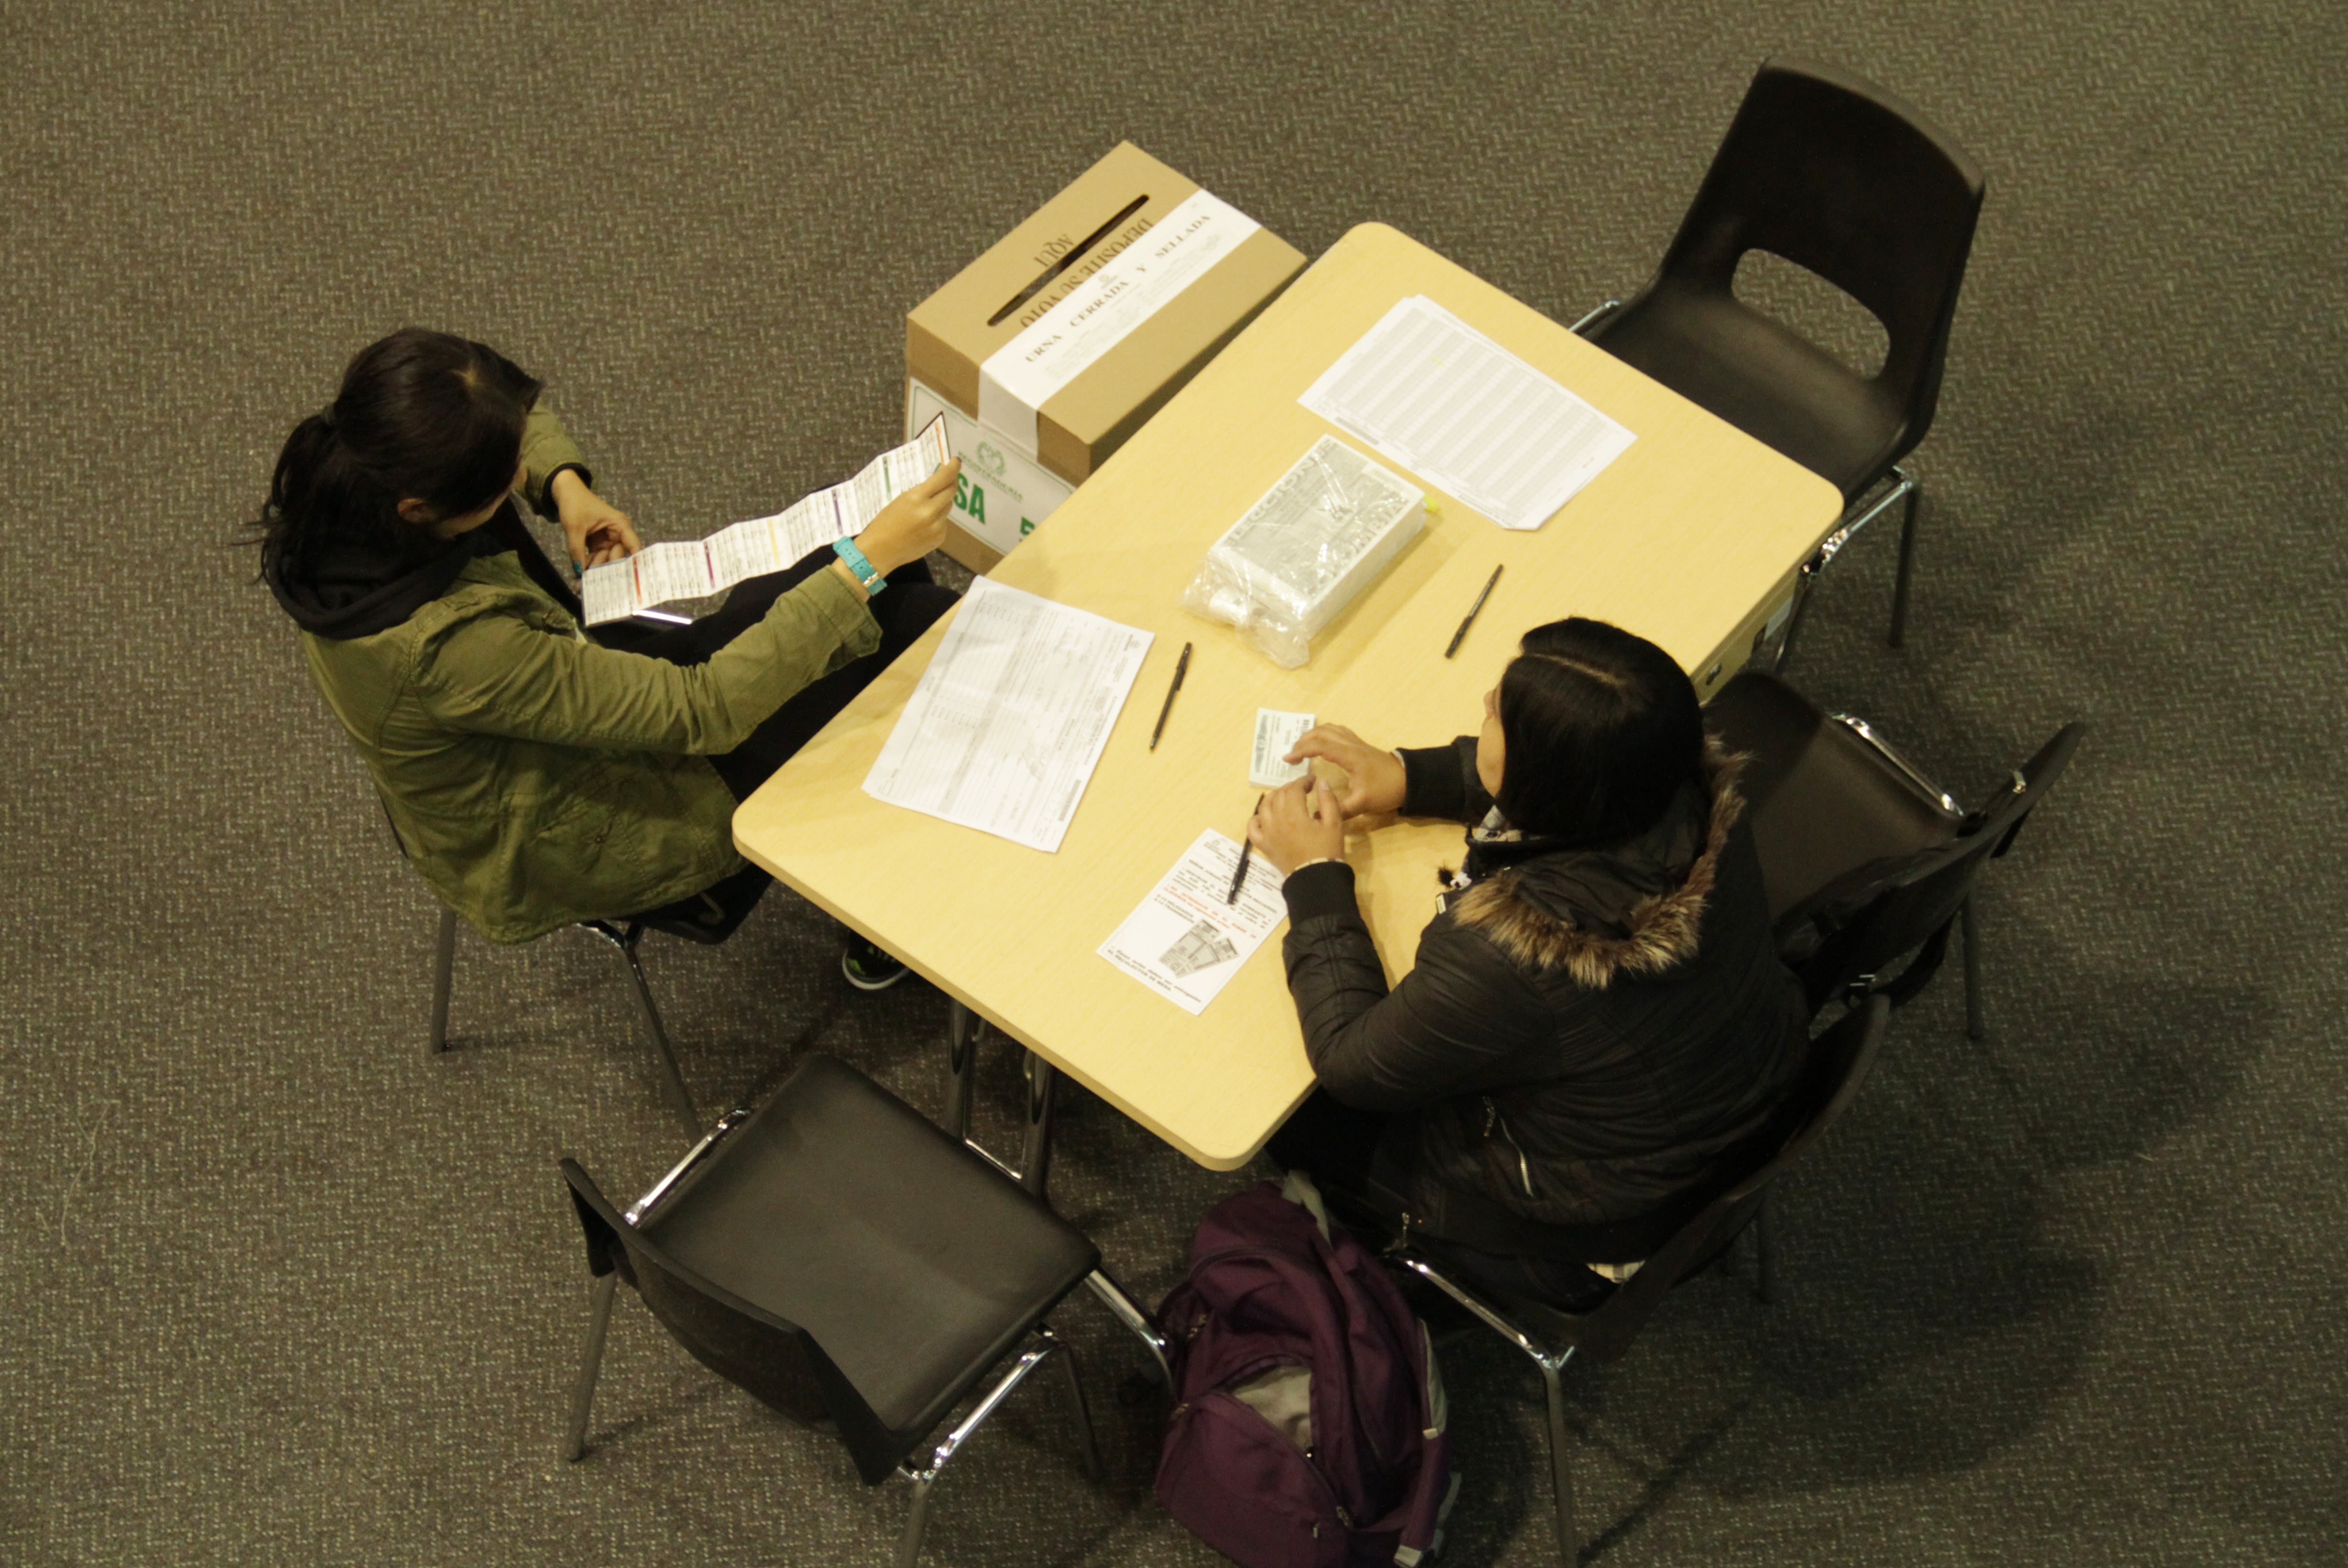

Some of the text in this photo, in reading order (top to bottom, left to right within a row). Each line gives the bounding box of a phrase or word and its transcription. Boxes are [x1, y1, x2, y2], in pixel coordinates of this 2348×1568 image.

[1026, 335, 1062, 362] URNA
[1070, 281, 1129, 326] CERRADA
[1136, 264, 1146, 274] Y
[1155, 215, 1210, 258] SELLADA
[953, 472, 985, 526] SA
